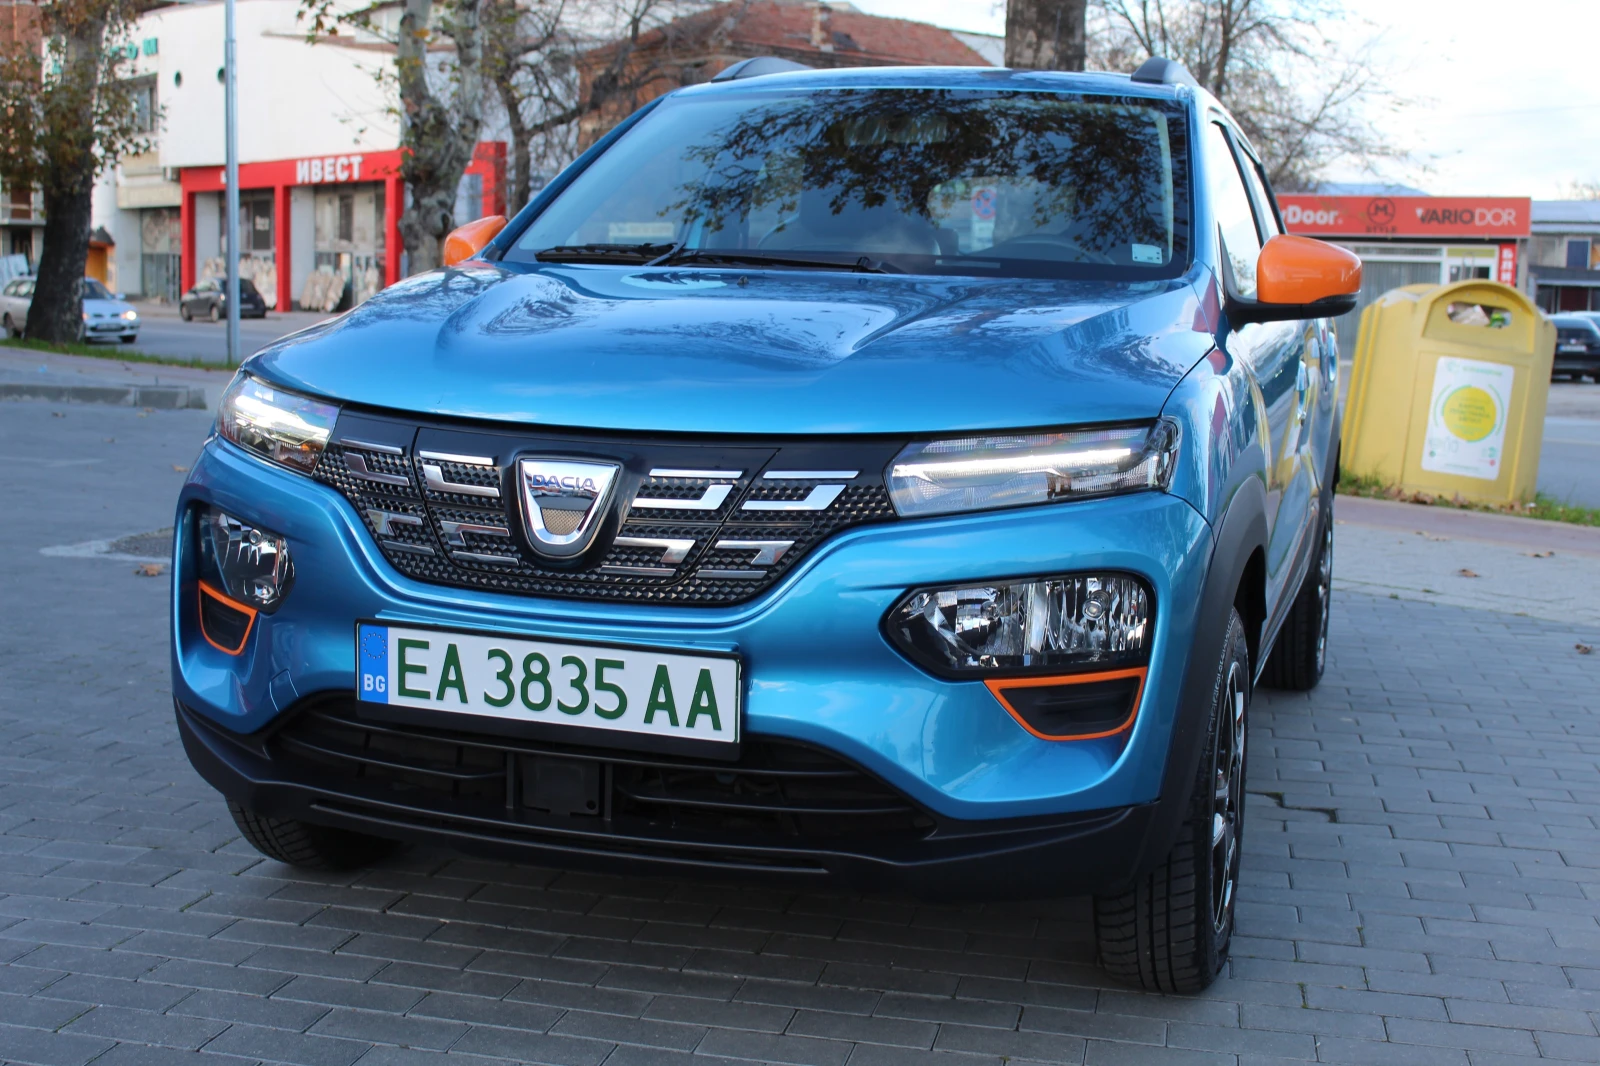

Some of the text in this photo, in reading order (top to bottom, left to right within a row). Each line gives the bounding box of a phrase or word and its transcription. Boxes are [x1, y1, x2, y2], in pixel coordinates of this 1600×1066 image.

[296, 155, 363, 184] ИВЕСТ
[532, 474, 597, 491] DACIA
[363, 673, 386, 693] BG
[397, 637, 723, 731] EA 3835 AA
